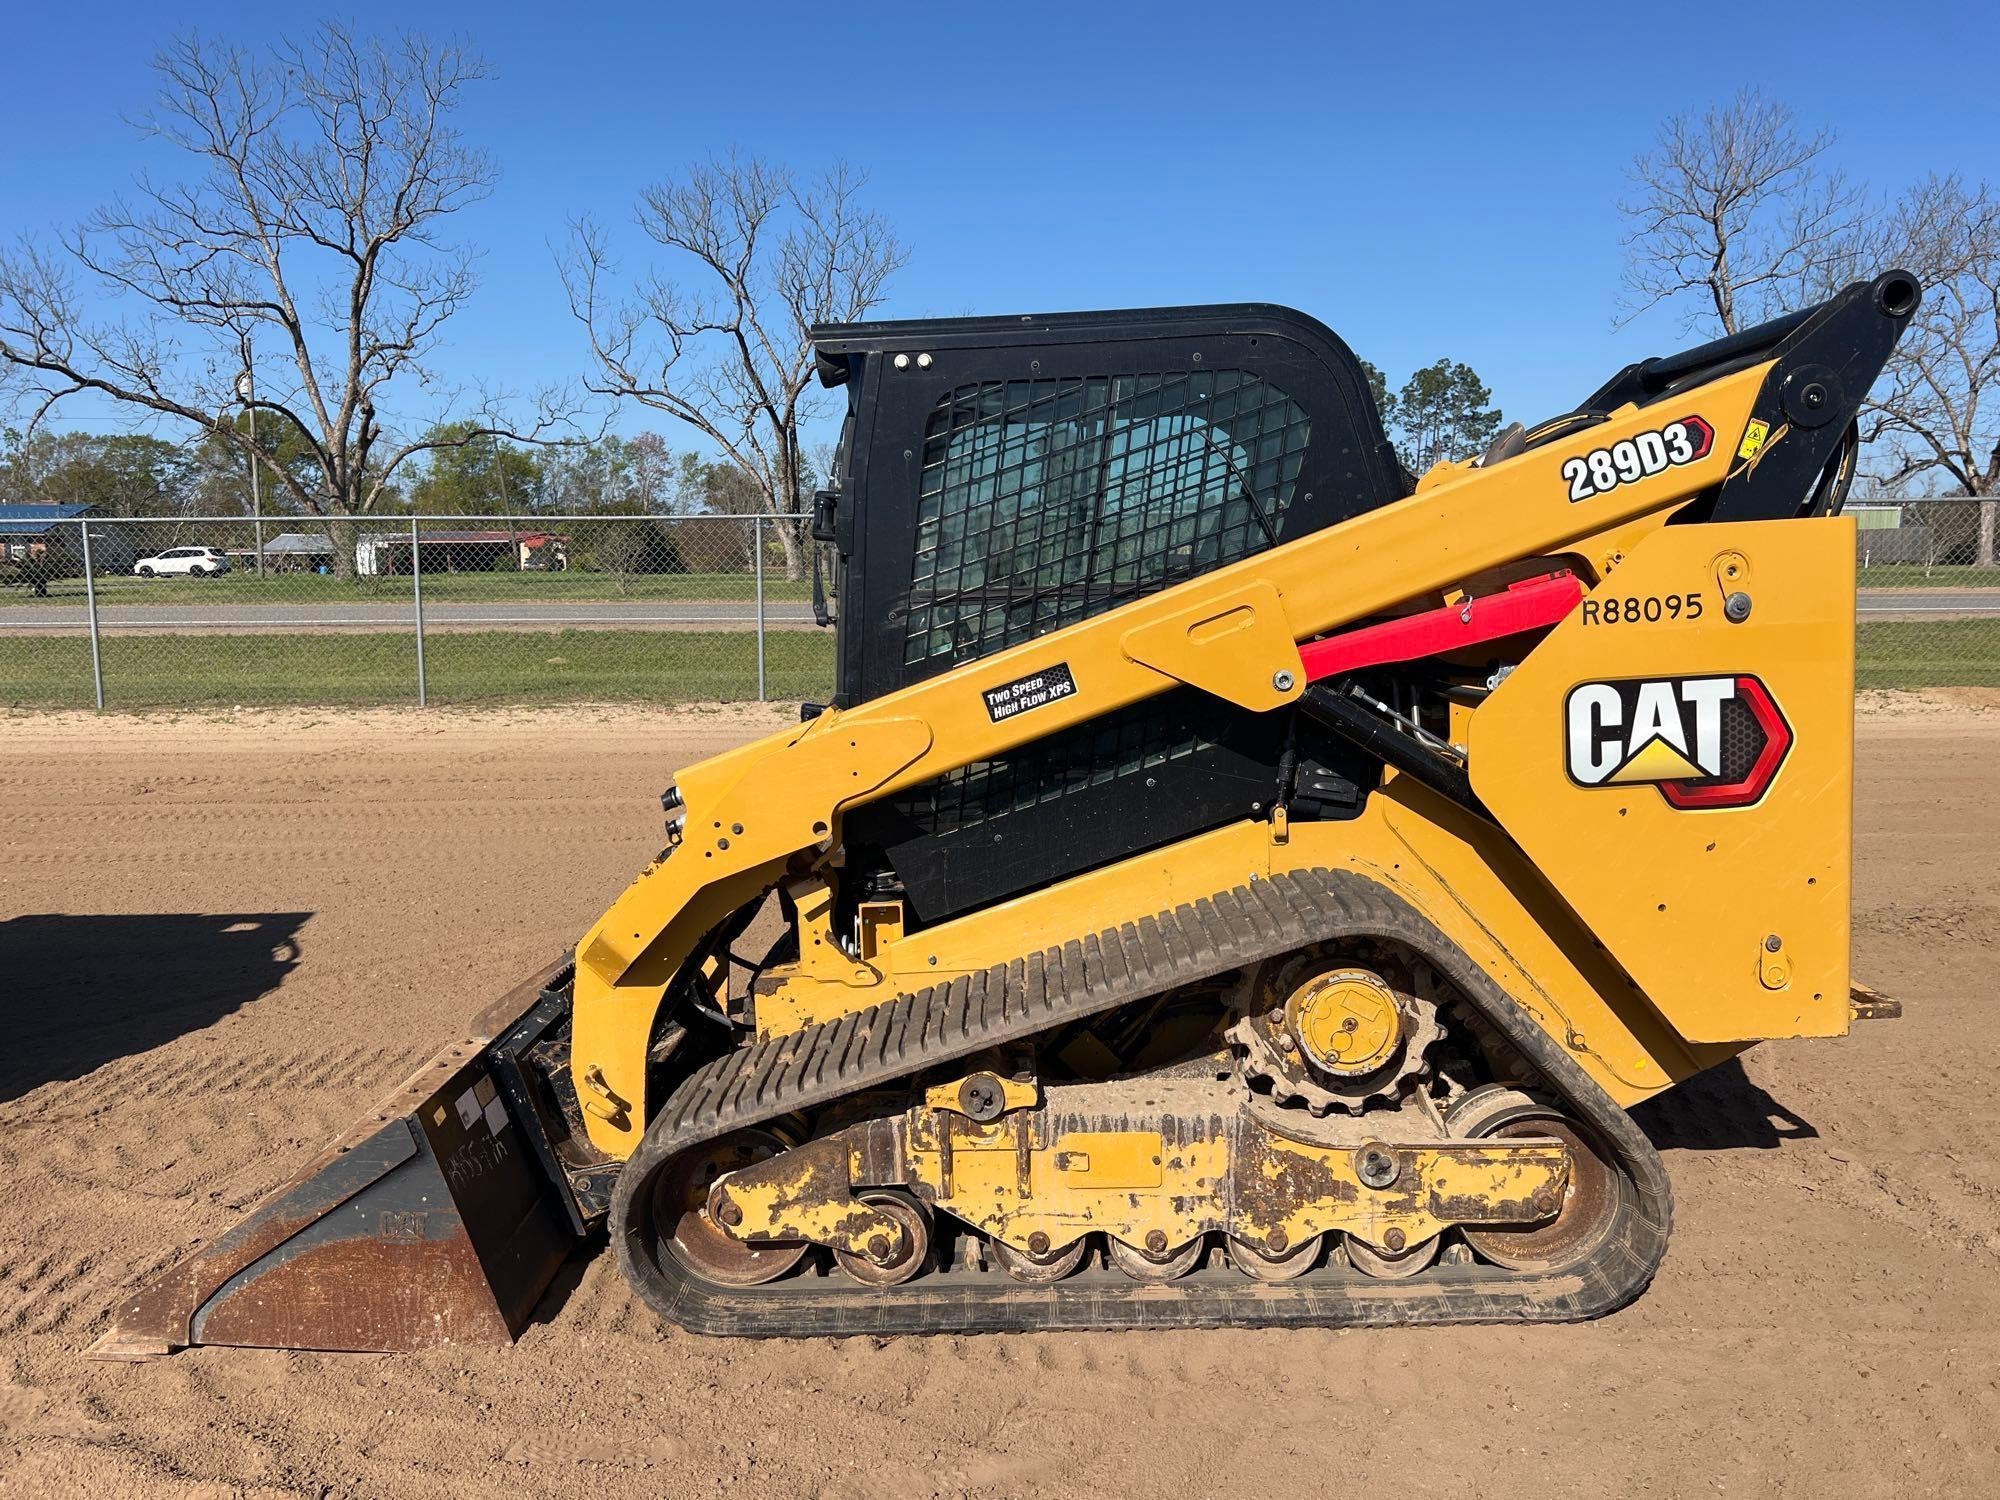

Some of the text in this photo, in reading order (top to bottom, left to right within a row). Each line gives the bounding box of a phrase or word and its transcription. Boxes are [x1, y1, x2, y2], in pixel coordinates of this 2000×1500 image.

[1563, 423, 1694, 501] 289D3
[1582, 593, 1703, 625] R88095
[1049, 681, 1071, 699] XPS
[1568, 678, 1735, 784] CAT
